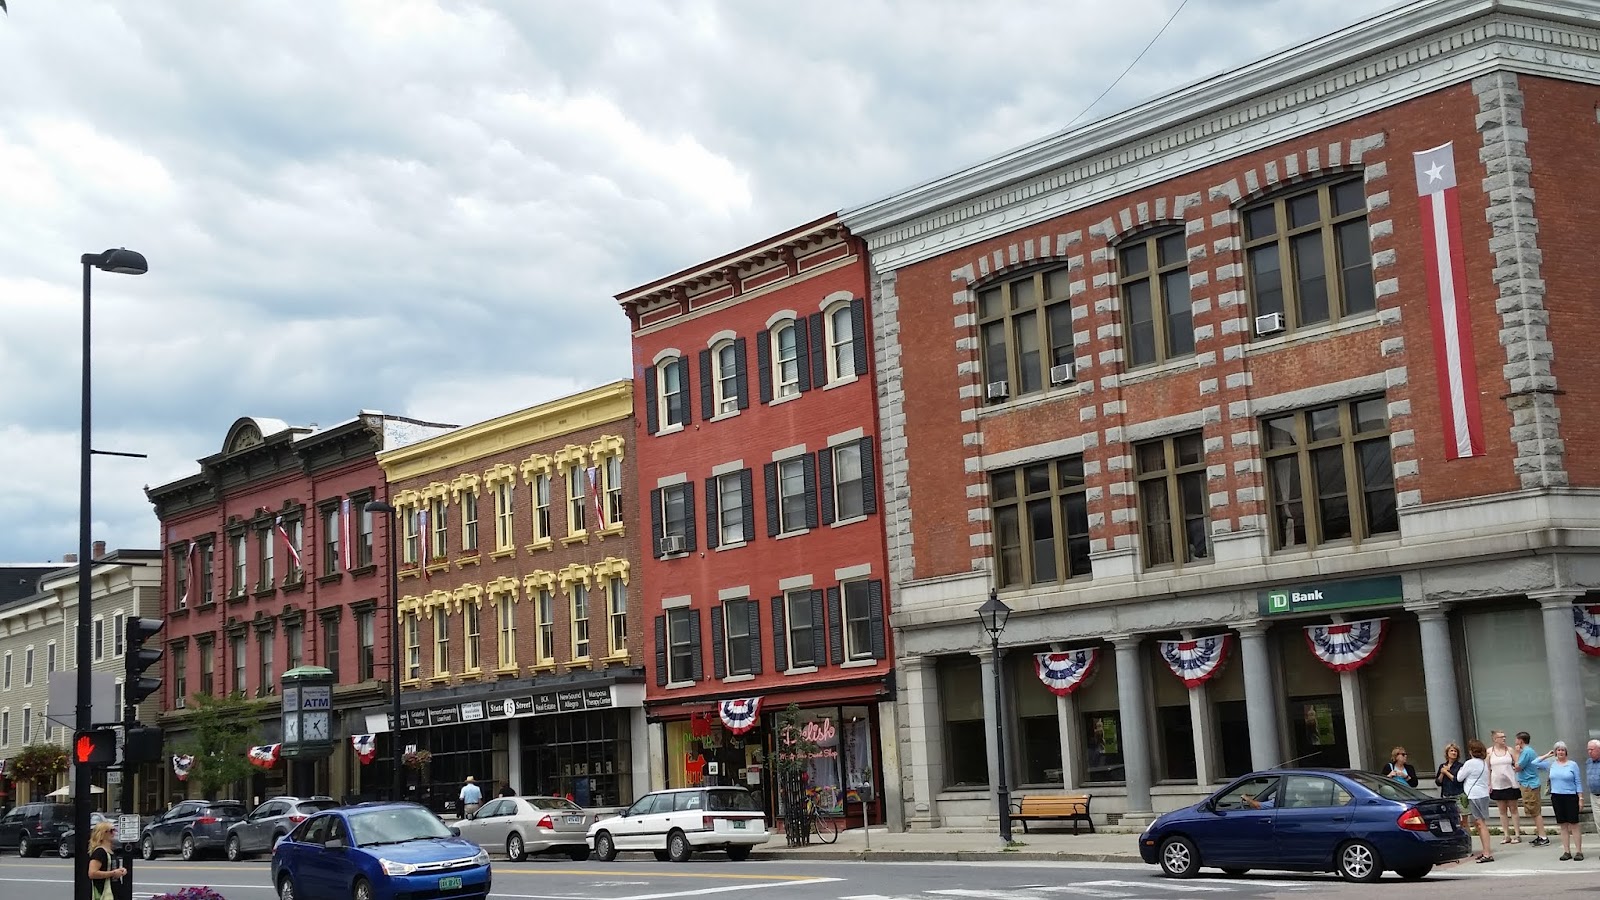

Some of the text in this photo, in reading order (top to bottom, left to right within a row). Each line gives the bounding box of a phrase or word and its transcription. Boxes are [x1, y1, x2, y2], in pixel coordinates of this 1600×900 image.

[1271, 590, 1323, 608] TD Bank
[304, 698, 328, 707] ATM
[516, 701, 530, 709] Street
[565, 701, 579, 709] Allegro
[490, 704, 503, 712] State
[506, 703, 513, 713] 15
[823, 748, 838, 760] Shop
